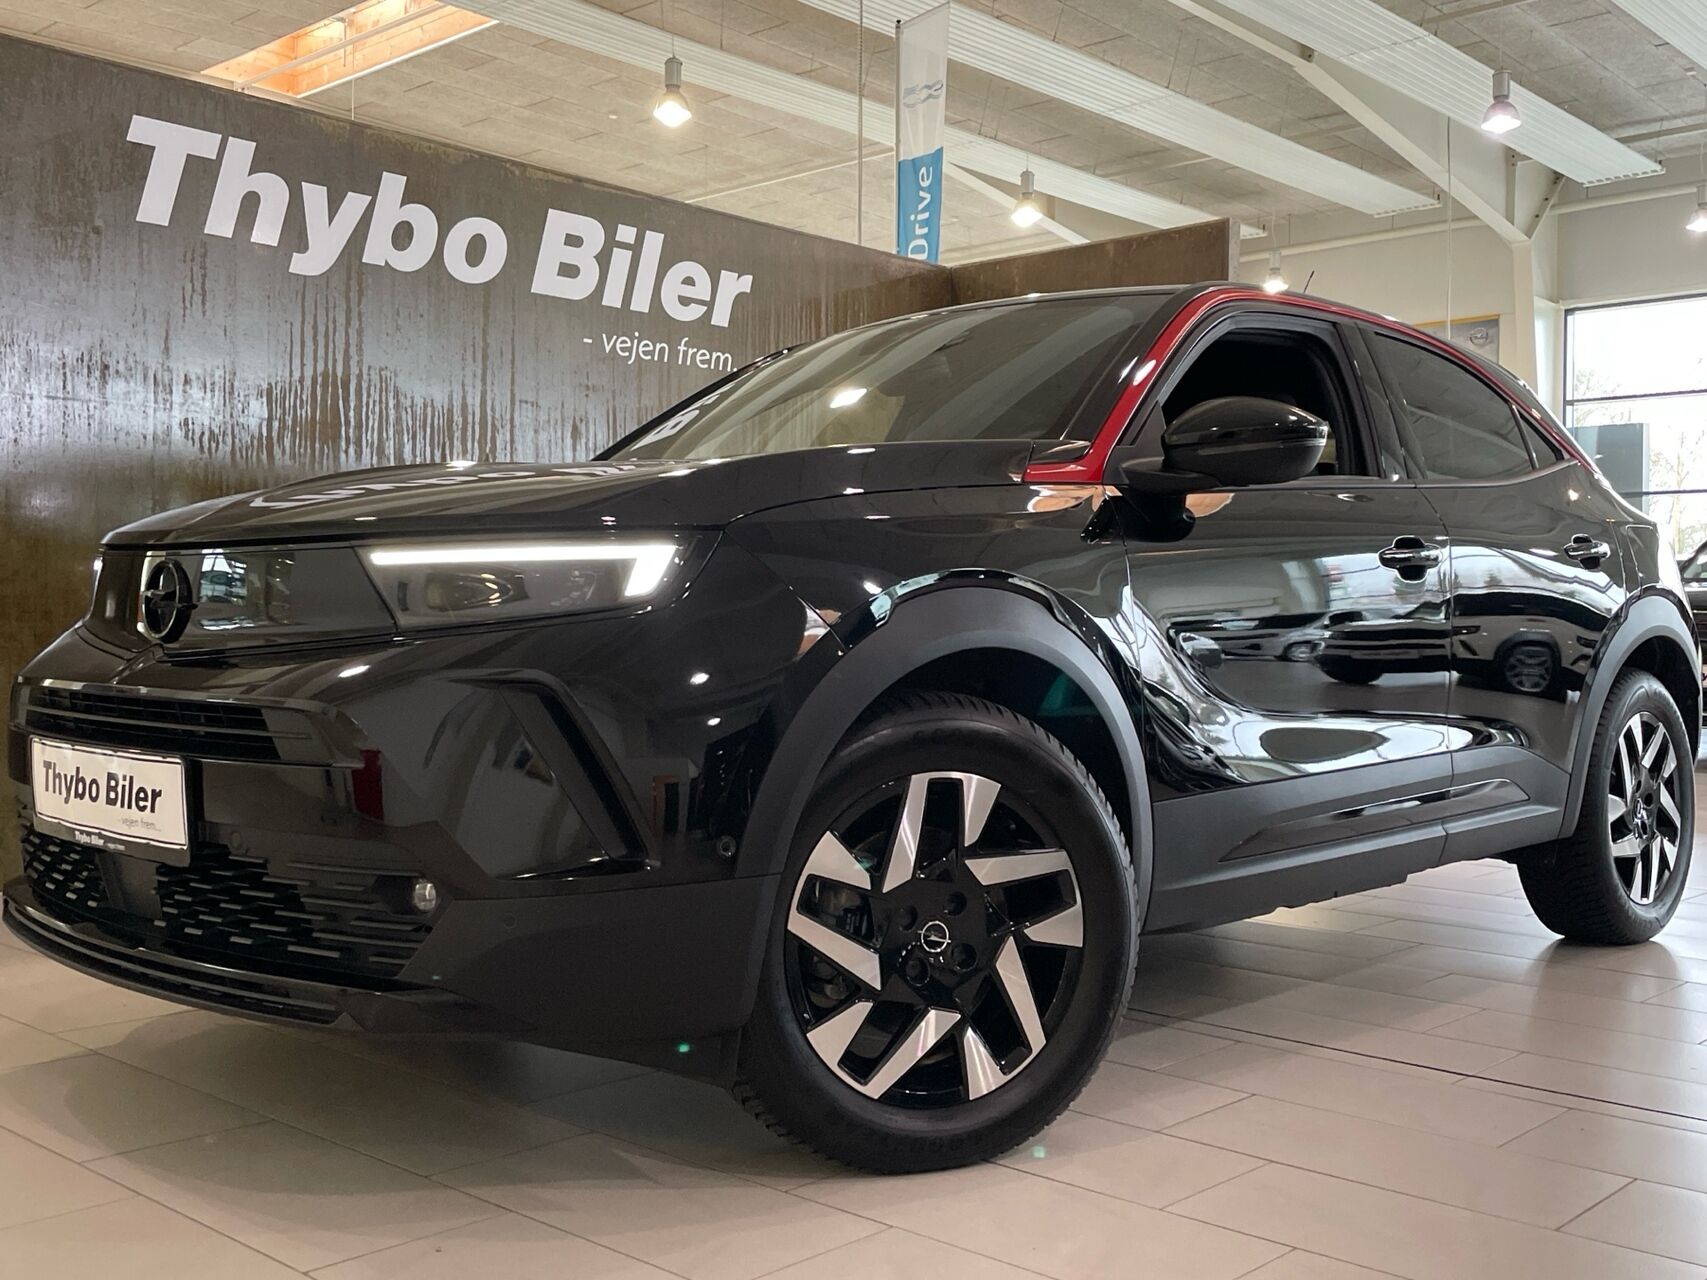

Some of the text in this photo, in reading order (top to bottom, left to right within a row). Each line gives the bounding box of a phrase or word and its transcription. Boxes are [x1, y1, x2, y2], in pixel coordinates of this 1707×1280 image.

[126, 114, 753, 328] Thybo Biler
[907, 166, 933, 260] Drive
[602, 331, 669, 365] vejen
[42, 760, 162, 814] Thybo Biler
